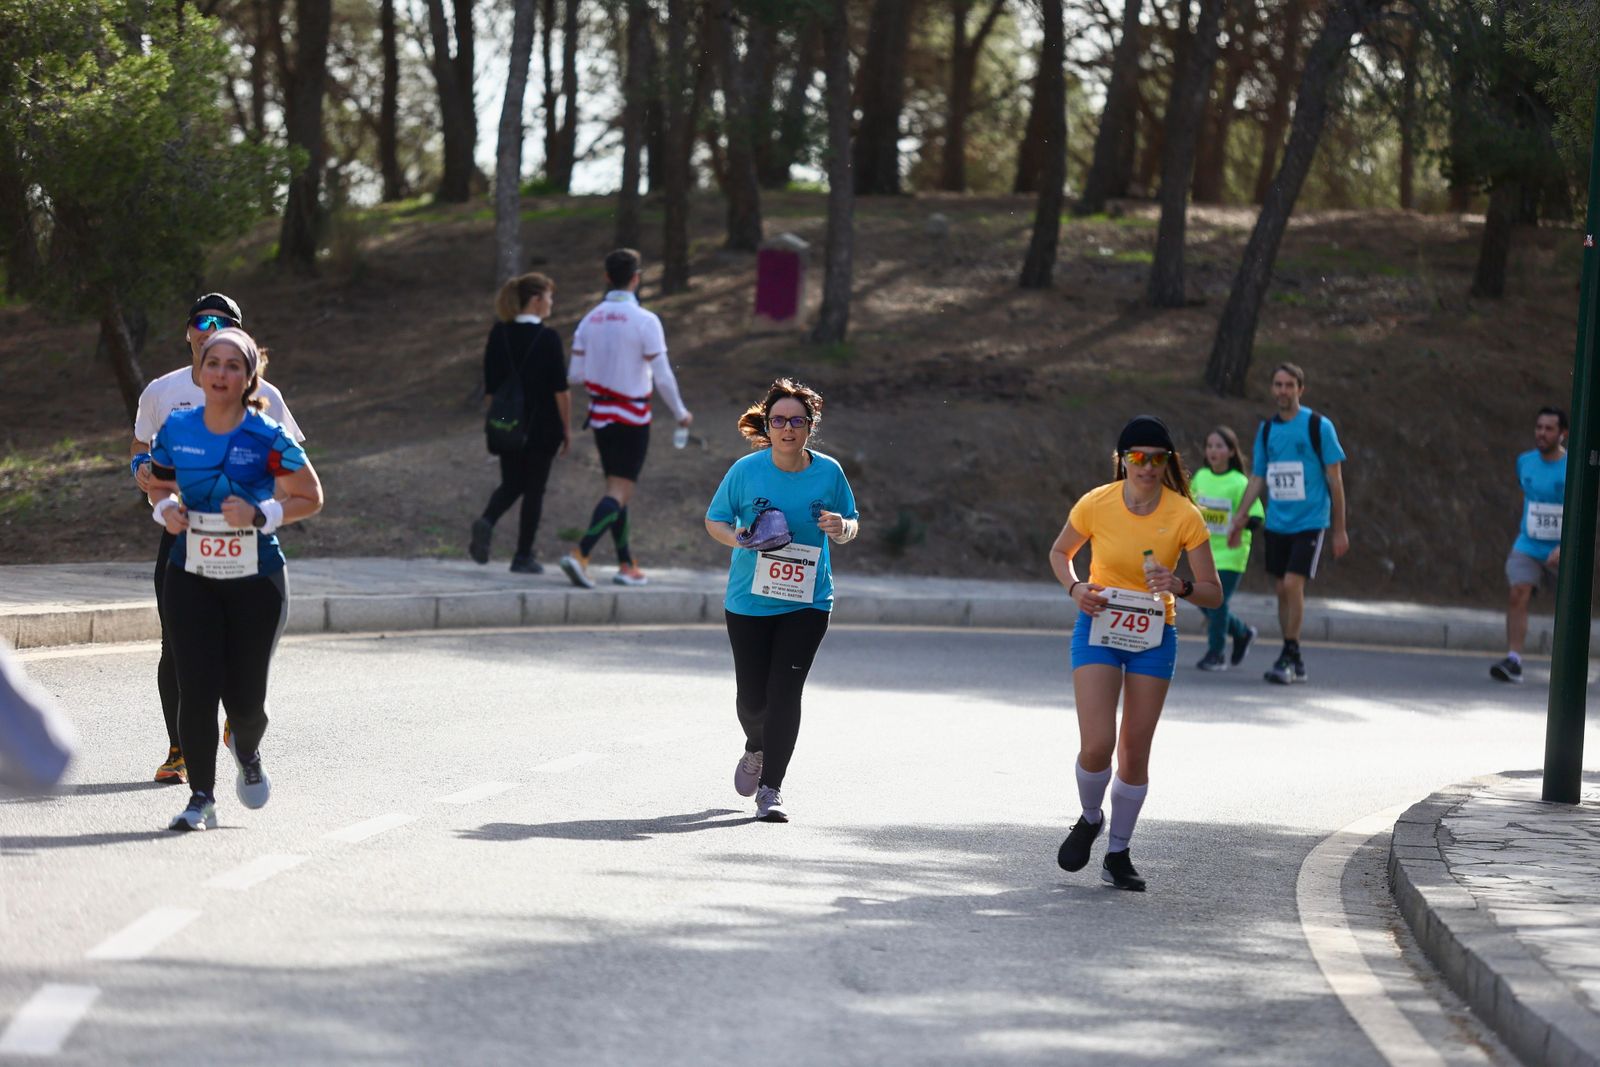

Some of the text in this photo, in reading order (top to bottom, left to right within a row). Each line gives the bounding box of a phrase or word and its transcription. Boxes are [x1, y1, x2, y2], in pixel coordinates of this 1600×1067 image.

[1535, 517, 1559, 529] 384
[200, 536, 242, 557] 626
[769, 561, 805, 583] 695
[1109, 610, 1151, 633] 749
